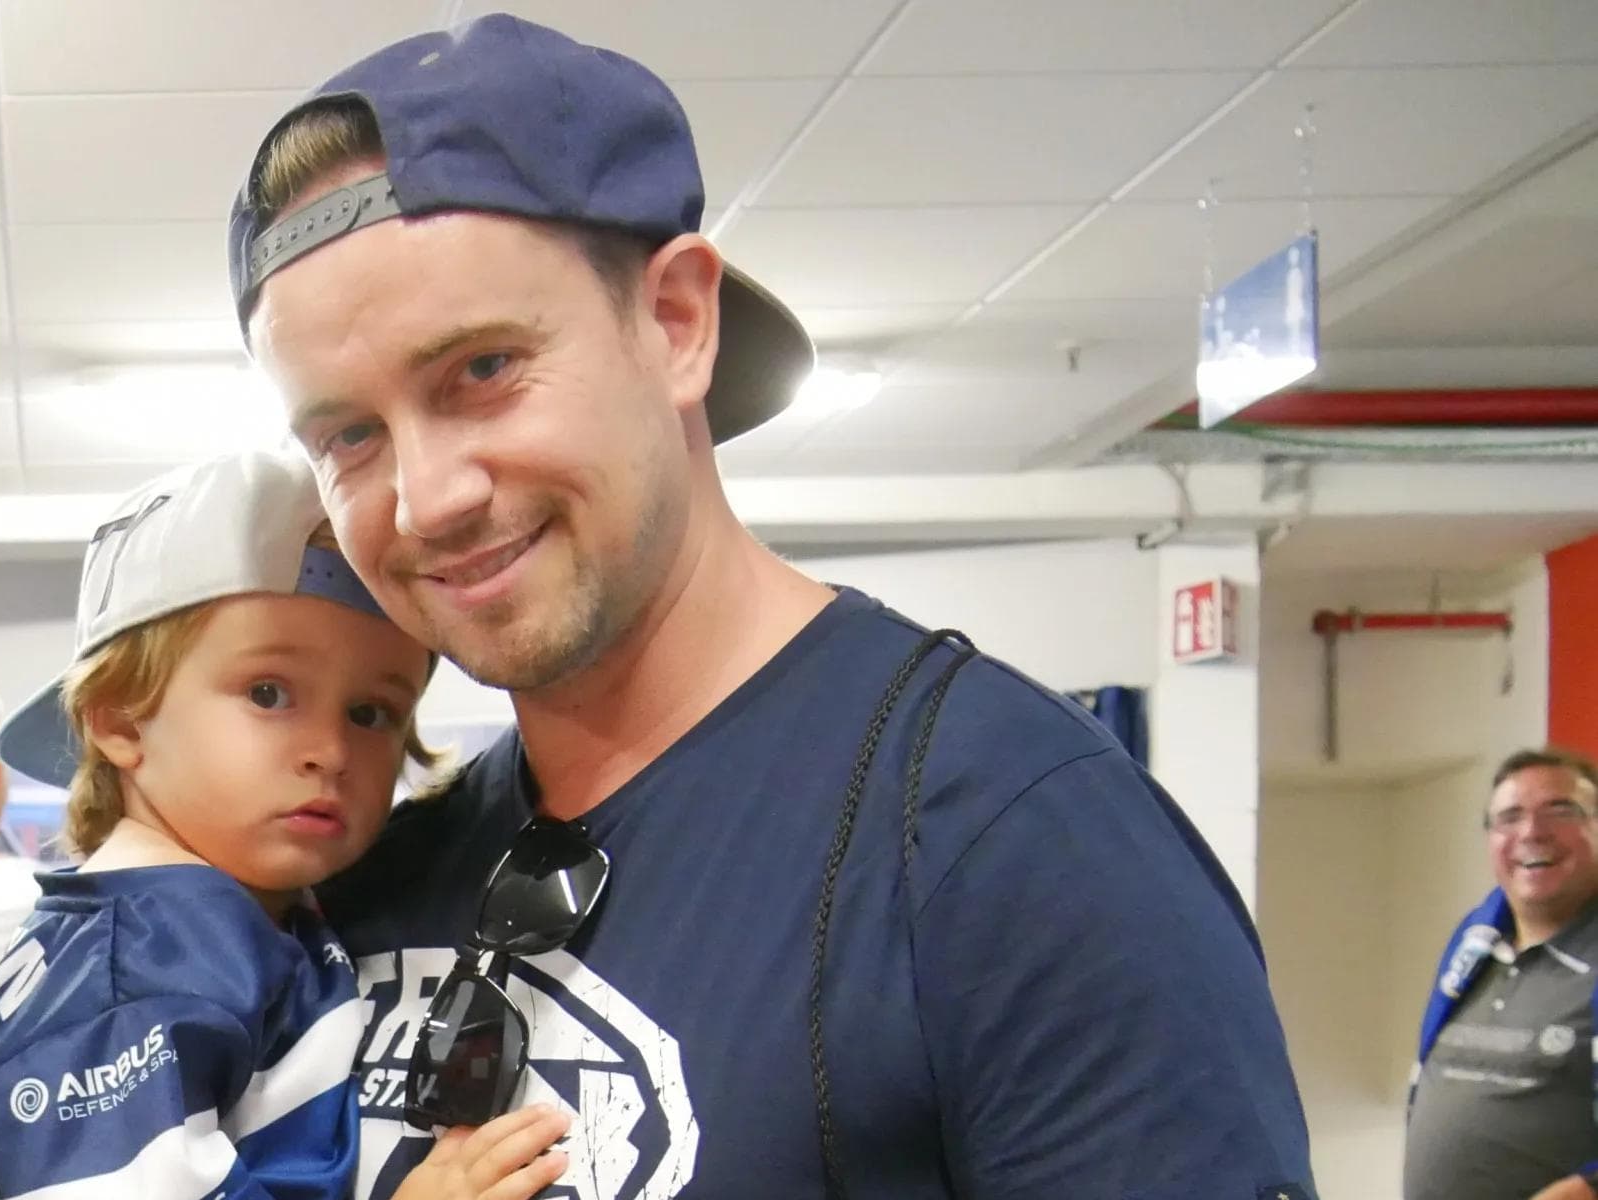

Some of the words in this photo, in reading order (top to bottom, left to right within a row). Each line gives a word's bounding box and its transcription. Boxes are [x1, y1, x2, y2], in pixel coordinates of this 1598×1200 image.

[57, 1023, 165, 1103] AIRBUS
[57, 1074, 138, 1122] DEFENCE
[139, 1069, 150, 1082] &
